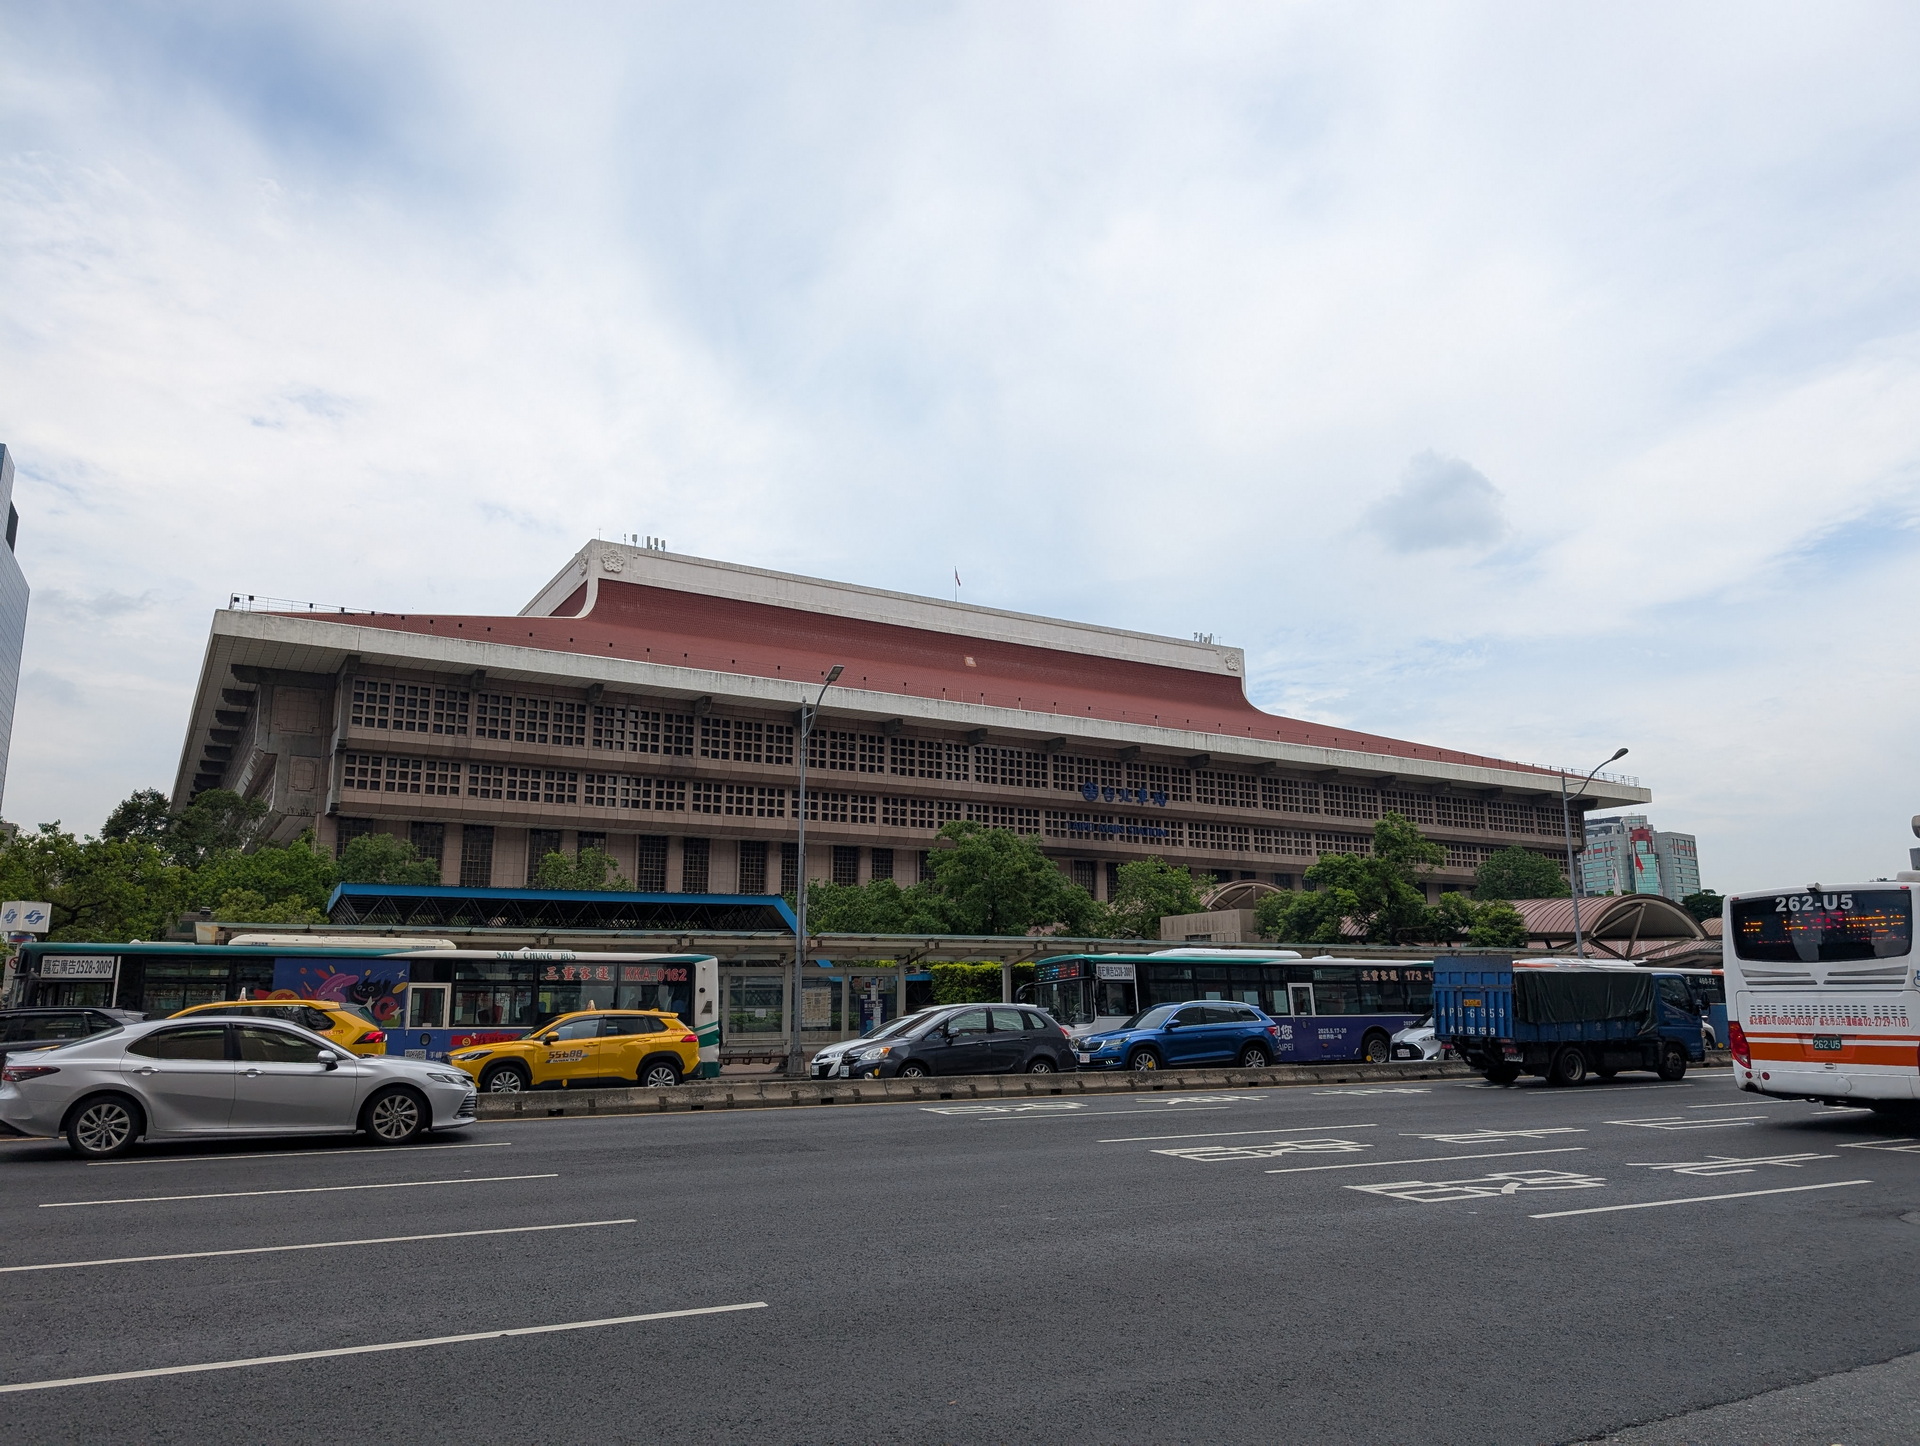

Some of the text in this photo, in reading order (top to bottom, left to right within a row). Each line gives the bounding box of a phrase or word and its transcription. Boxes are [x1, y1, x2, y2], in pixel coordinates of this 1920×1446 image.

[1103, 785, 1167, 807] 台北車站
[1067, 821, 1167, 837] TAIPEI MAIN STATION
[1775, 894, 1853, 912] 262-U5
[496, 951, 577, 960] SAN CHUNG BUS
[544, 965, 611, 981] 三重客運
[624, 967, 688, 982] KKA-0162
[1814, 1039, 1841, 1049] 262-U5
